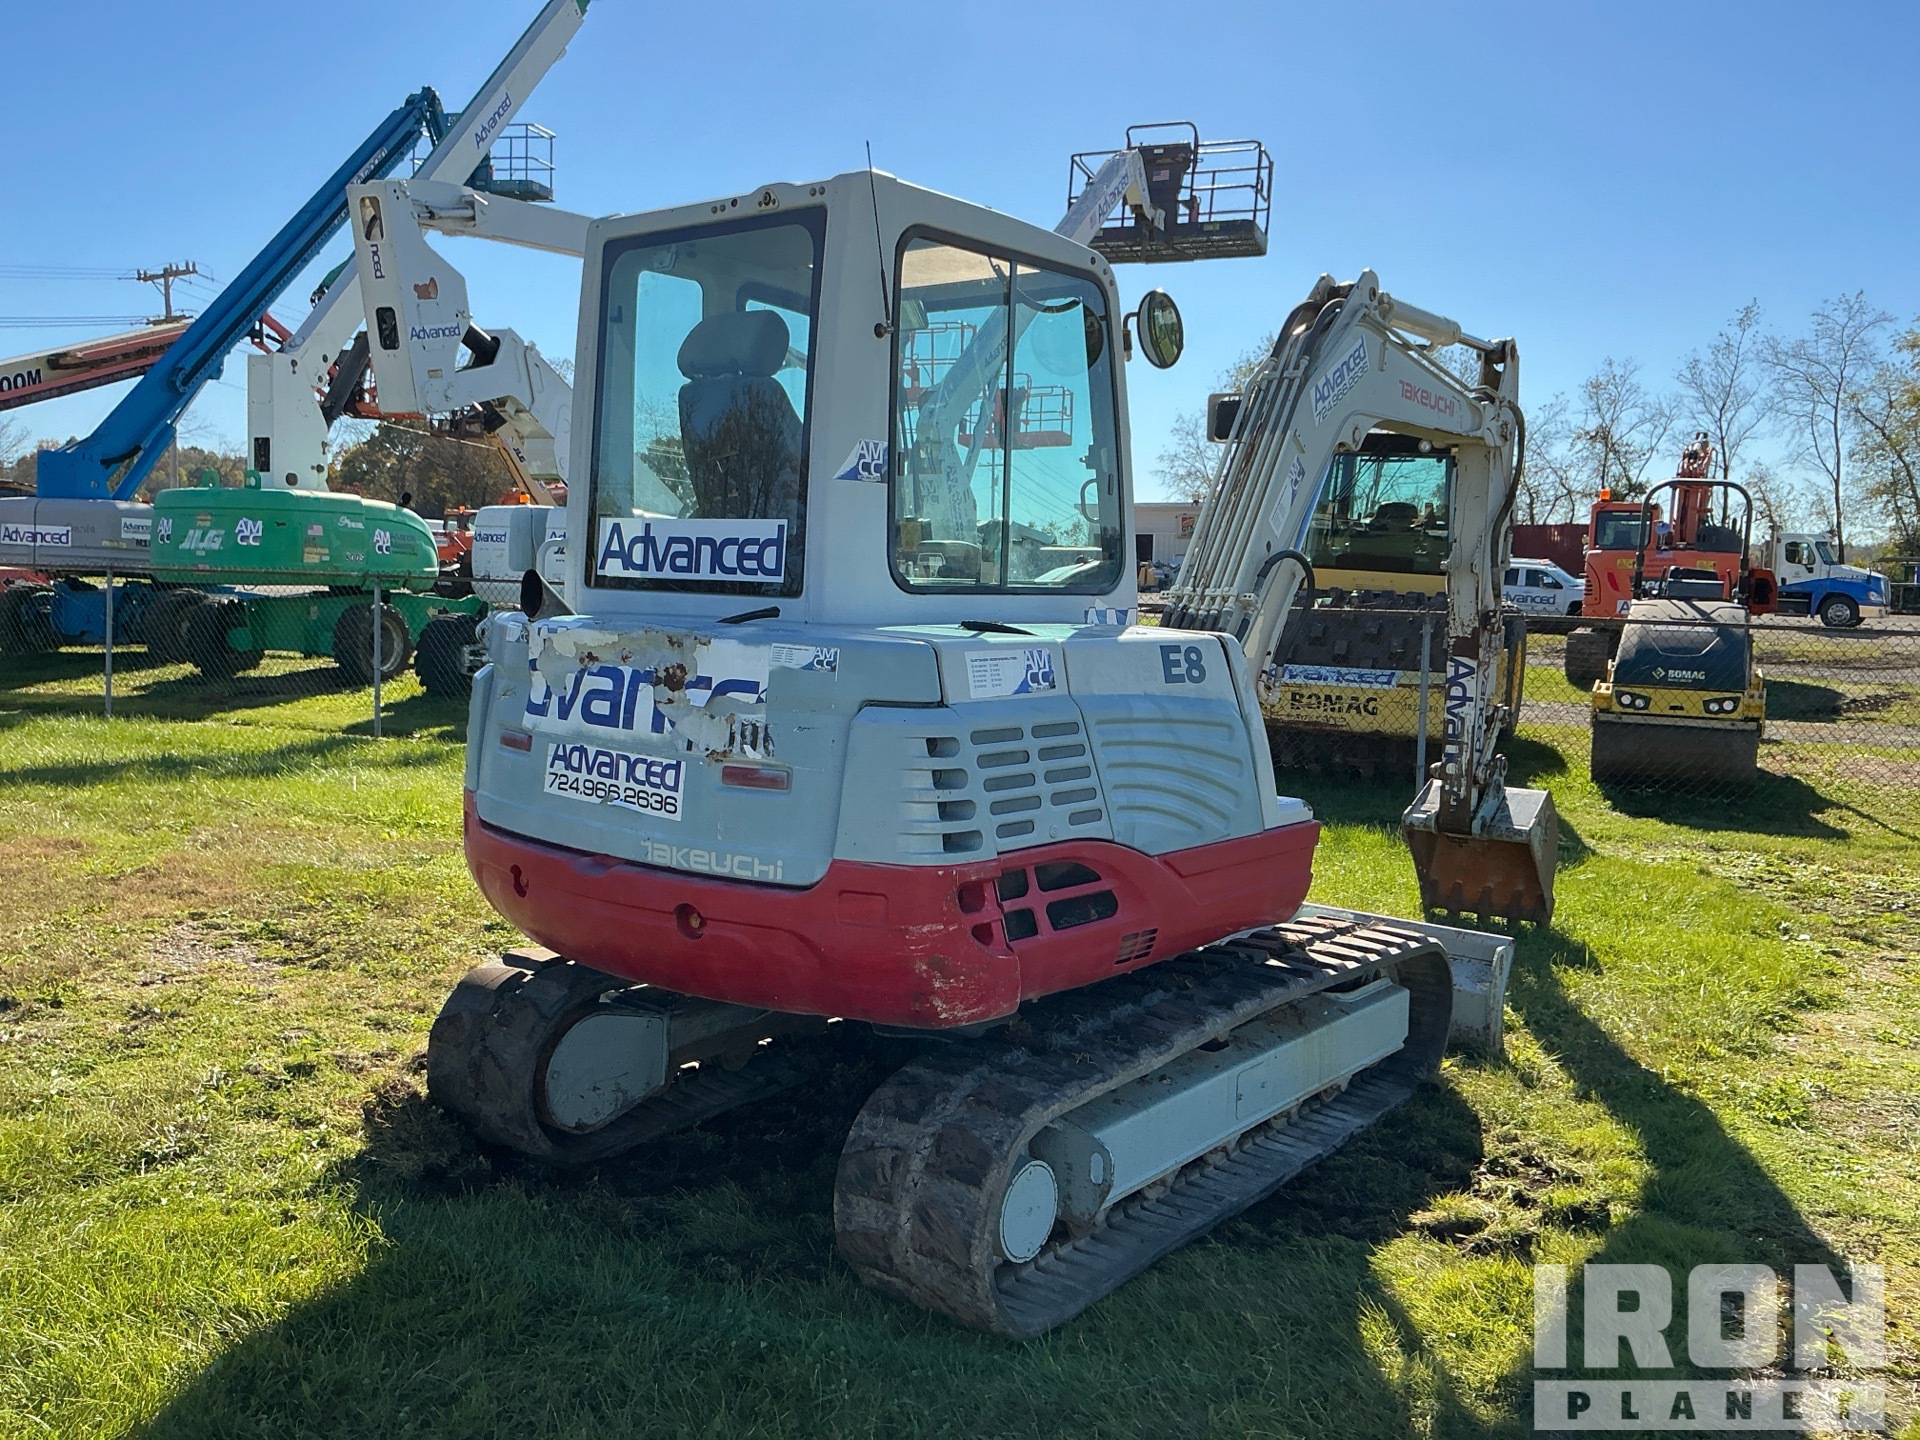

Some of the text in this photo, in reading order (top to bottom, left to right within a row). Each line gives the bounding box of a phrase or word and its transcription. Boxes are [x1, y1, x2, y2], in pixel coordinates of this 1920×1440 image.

[474, 92, 512, 149] Advanced
[410, 323, 461, 340] Advanced
[1314, 335, 1368, 412] Advanced
[2, 527, 70, 544] Advanced
[599, 522, 785, 577] Advanced
[1502, 591, 1556, 605] dvanced
[1159, 644, 1207, 684] E8
[1667, 669, 1706, 680] BOMAG
[1290, 691, 1378, 716] BOMAG
[549, 744, 682, 793] Advanced
[548, 772, 679, 815] 724.966.2636
